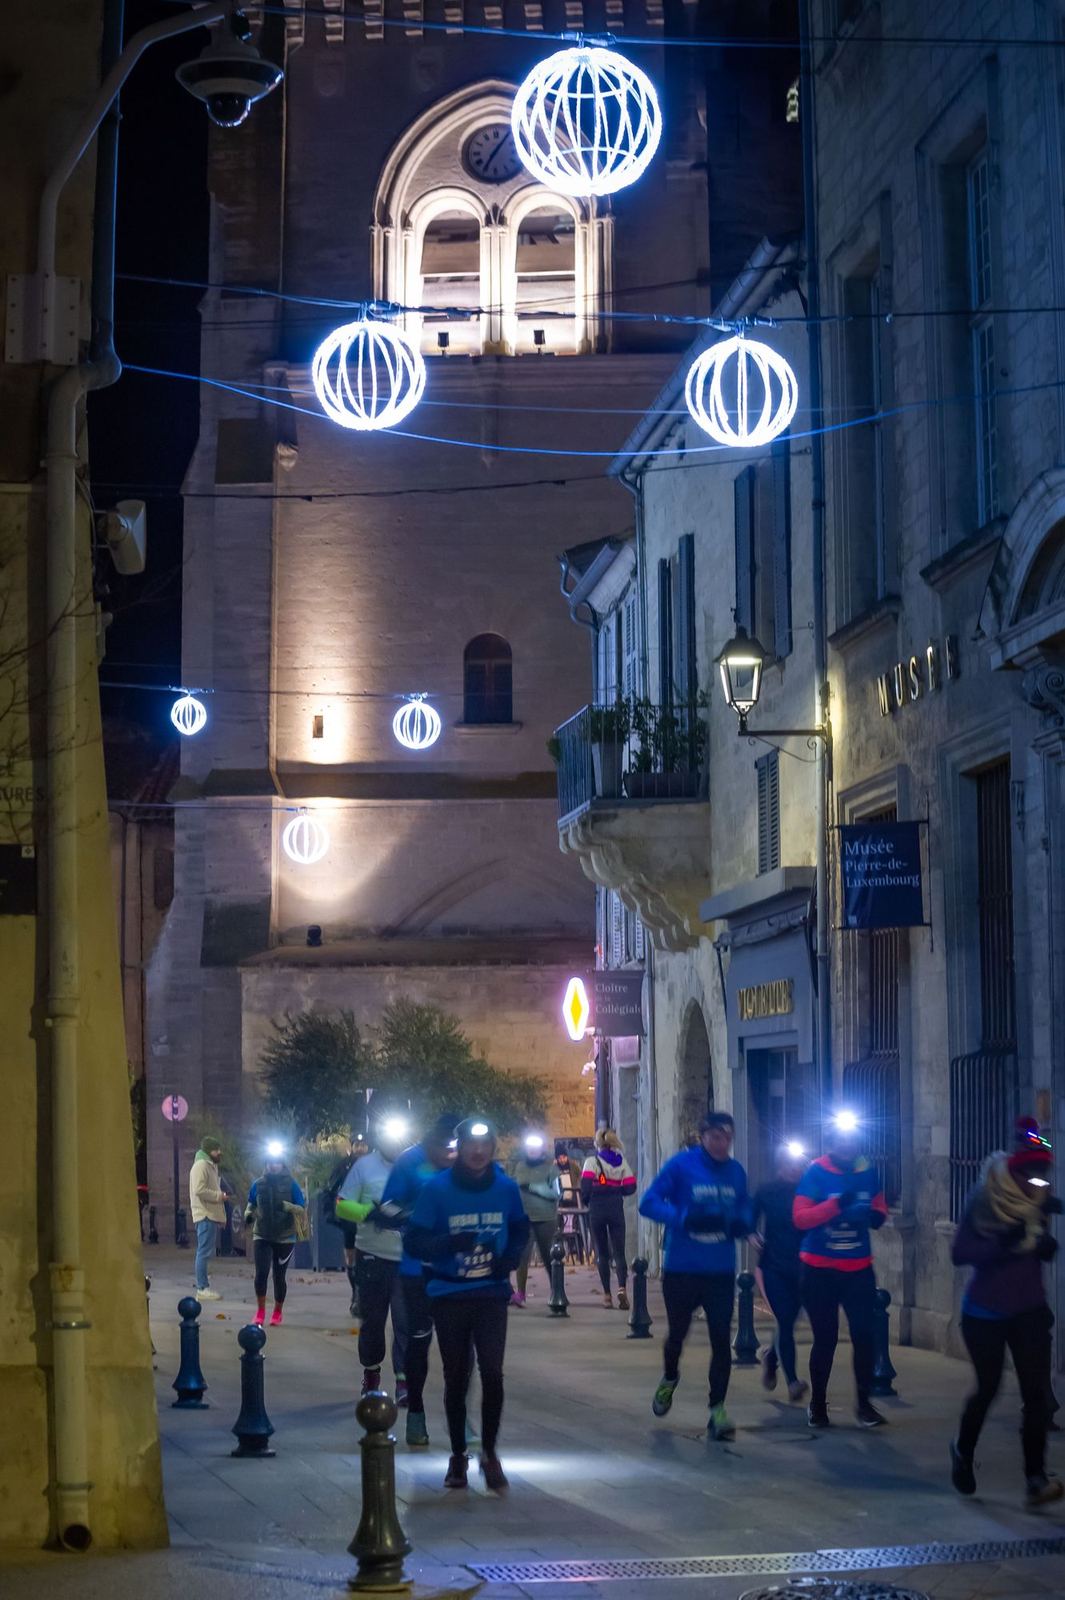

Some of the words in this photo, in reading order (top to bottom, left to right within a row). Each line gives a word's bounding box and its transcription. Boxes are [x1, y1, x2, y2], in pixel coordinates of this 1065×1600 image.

[0, 787, 45, 802] URES
[845, 839, 895, 856] Musée
[846, 858, 908, 872] Pierre-de-
[846, 874, 920, 888] Luxembourg
